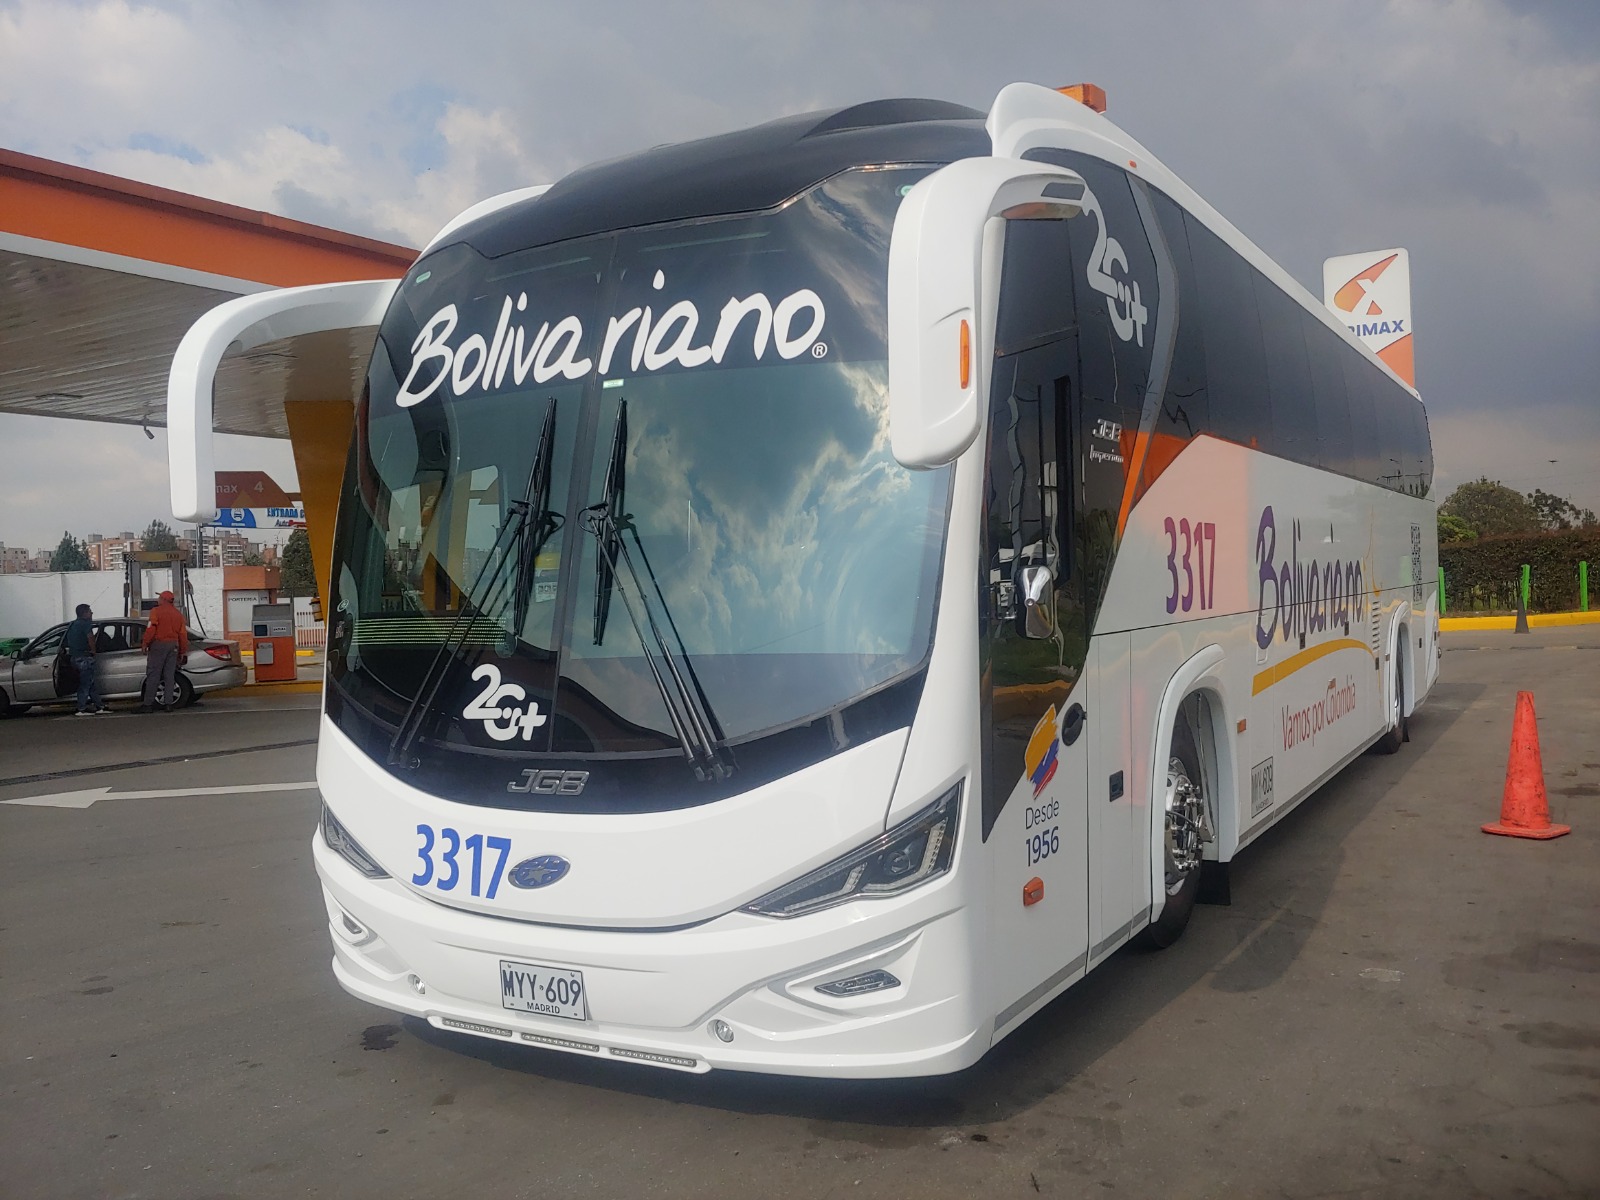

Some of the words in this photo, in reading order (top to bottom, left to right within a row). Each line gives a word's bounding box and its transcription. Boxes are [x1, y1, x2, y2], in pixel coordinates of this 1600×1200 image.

[254, 481, 264, 493] 4
[1164, 516, 1216, 614] 3317
[1281, 704, 1311, 752] Vamos
[1312, 699, 1326, 747] por
[1326, 674, 1356, 726] Colombia
[506, 768, 590, 796] JGB
[1025, 796, 1060, 830] Desde
[411, 823, 512, 900] 3317
[1025, 825, 1060, 867] 1956
[526, 1001, 561, 1014] MADRID
